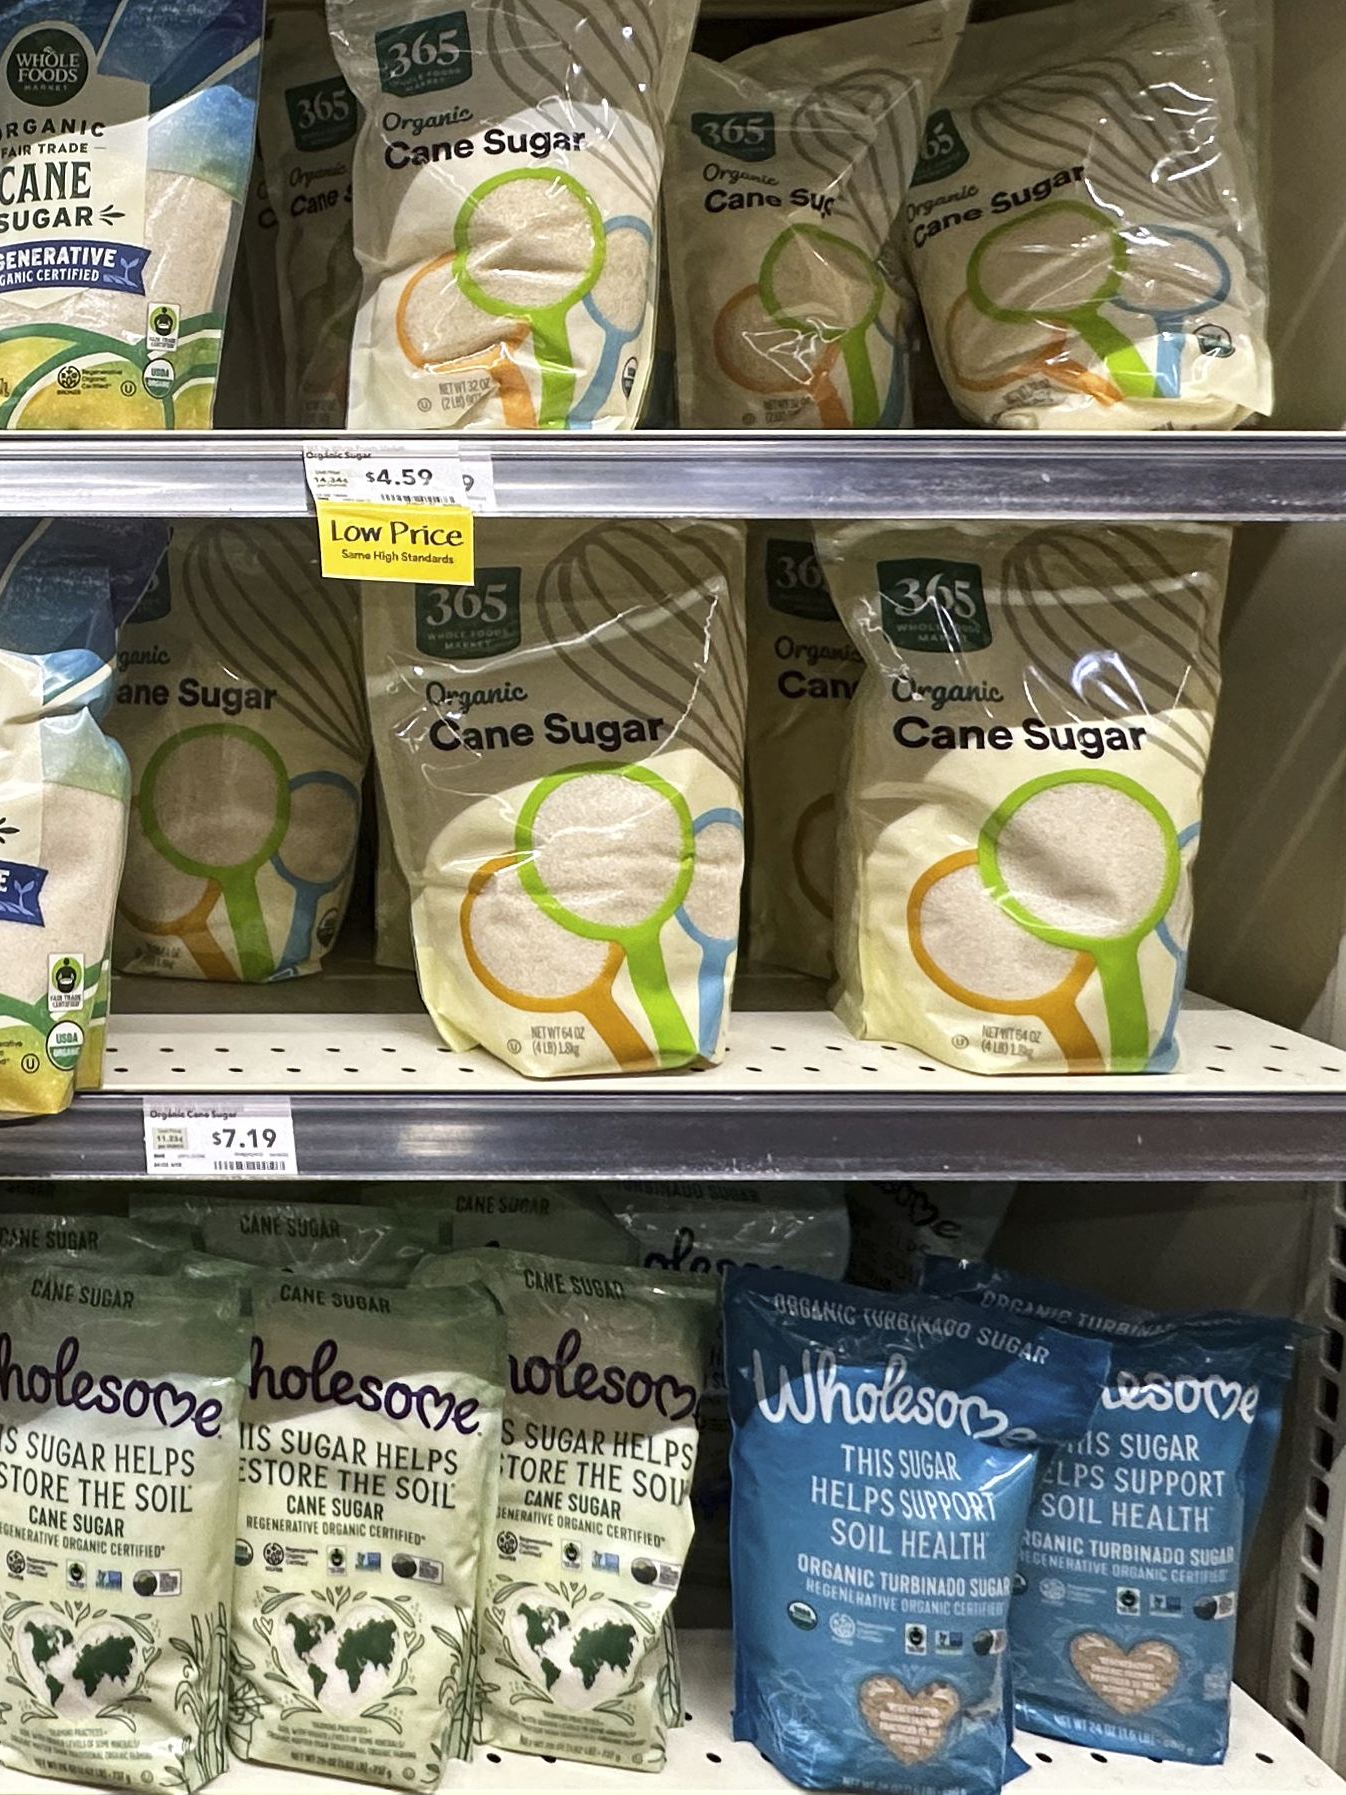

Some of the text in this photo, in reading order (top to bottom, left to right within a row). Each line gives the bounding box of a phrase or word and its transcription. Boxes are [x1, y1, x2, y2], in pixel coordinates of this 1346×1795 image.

[387, 30, 460, 77] 365
[383, 106, 473, 136] Organic
[702, 116, 764, 145] 365
[384, 129, 585, 170] Cane Sugar
[704, 164, 779, 186] Organic
[705, 189, 782, 213] Cane
[913, 166, 1084, 248] Cane Sugar
[306, 452, 371, 460] Organic Sugar
[366, 469, 433, 486] $4.59
[331, 520, 464, 546] Low Price
[342, 549, 454, 564] Same High Standards
[426, 584, 507, 626] 365
[895, 573, 976, 618] 365
[177, 679, 276, 716] Sugar
[426, 681, 528, 714] Organic
[892, 681, 1003, 710] Organic
[430, 712, 664, 752] Cane Sugar
[893, 716, 1146, 759] Cane Sugar
[56, 1033, 78, 1044] USDA
[150, 1111, 185, 1120] Organic
[212, 1111, 236, 1120] Sugar
[212, 1129, 276, 1148] $7.19
[31, 1279, 134, 1309] CANE SUGAR
[26, 1431, 106, 1473] SUGAR
[115, 1444, 195, 1477] HELPS
[280, 1429, 458, 1476] SUGAR HELPS
[525, 1422, 693, 1471] SUGAR HELPS
[841, 1444, 962, 1481] THIS SUGAR
[1119, 1434, 1200, 1462] SUGAR
[79, 1479, 125, 1511] THE
[338, 1469, 386, 1496] THE
[811, 1475, 996, 1521] HELPS SUPPORT
[1114, 1467, 1225, 1498] SUPPORT
[29, 1506, 124, 1538] CANE SUGAR
[286, 1495, 384, 1521] CANE SUGAR
[1041, 1493, 1102, 1525] SOIL
[830, 1517, 892, 1555] SOIL
[1089, 1539, 1184, 1565] TURBINADO
[798, 1553, 1010, 1597] ORGANIC TURBINADO SUGAR
